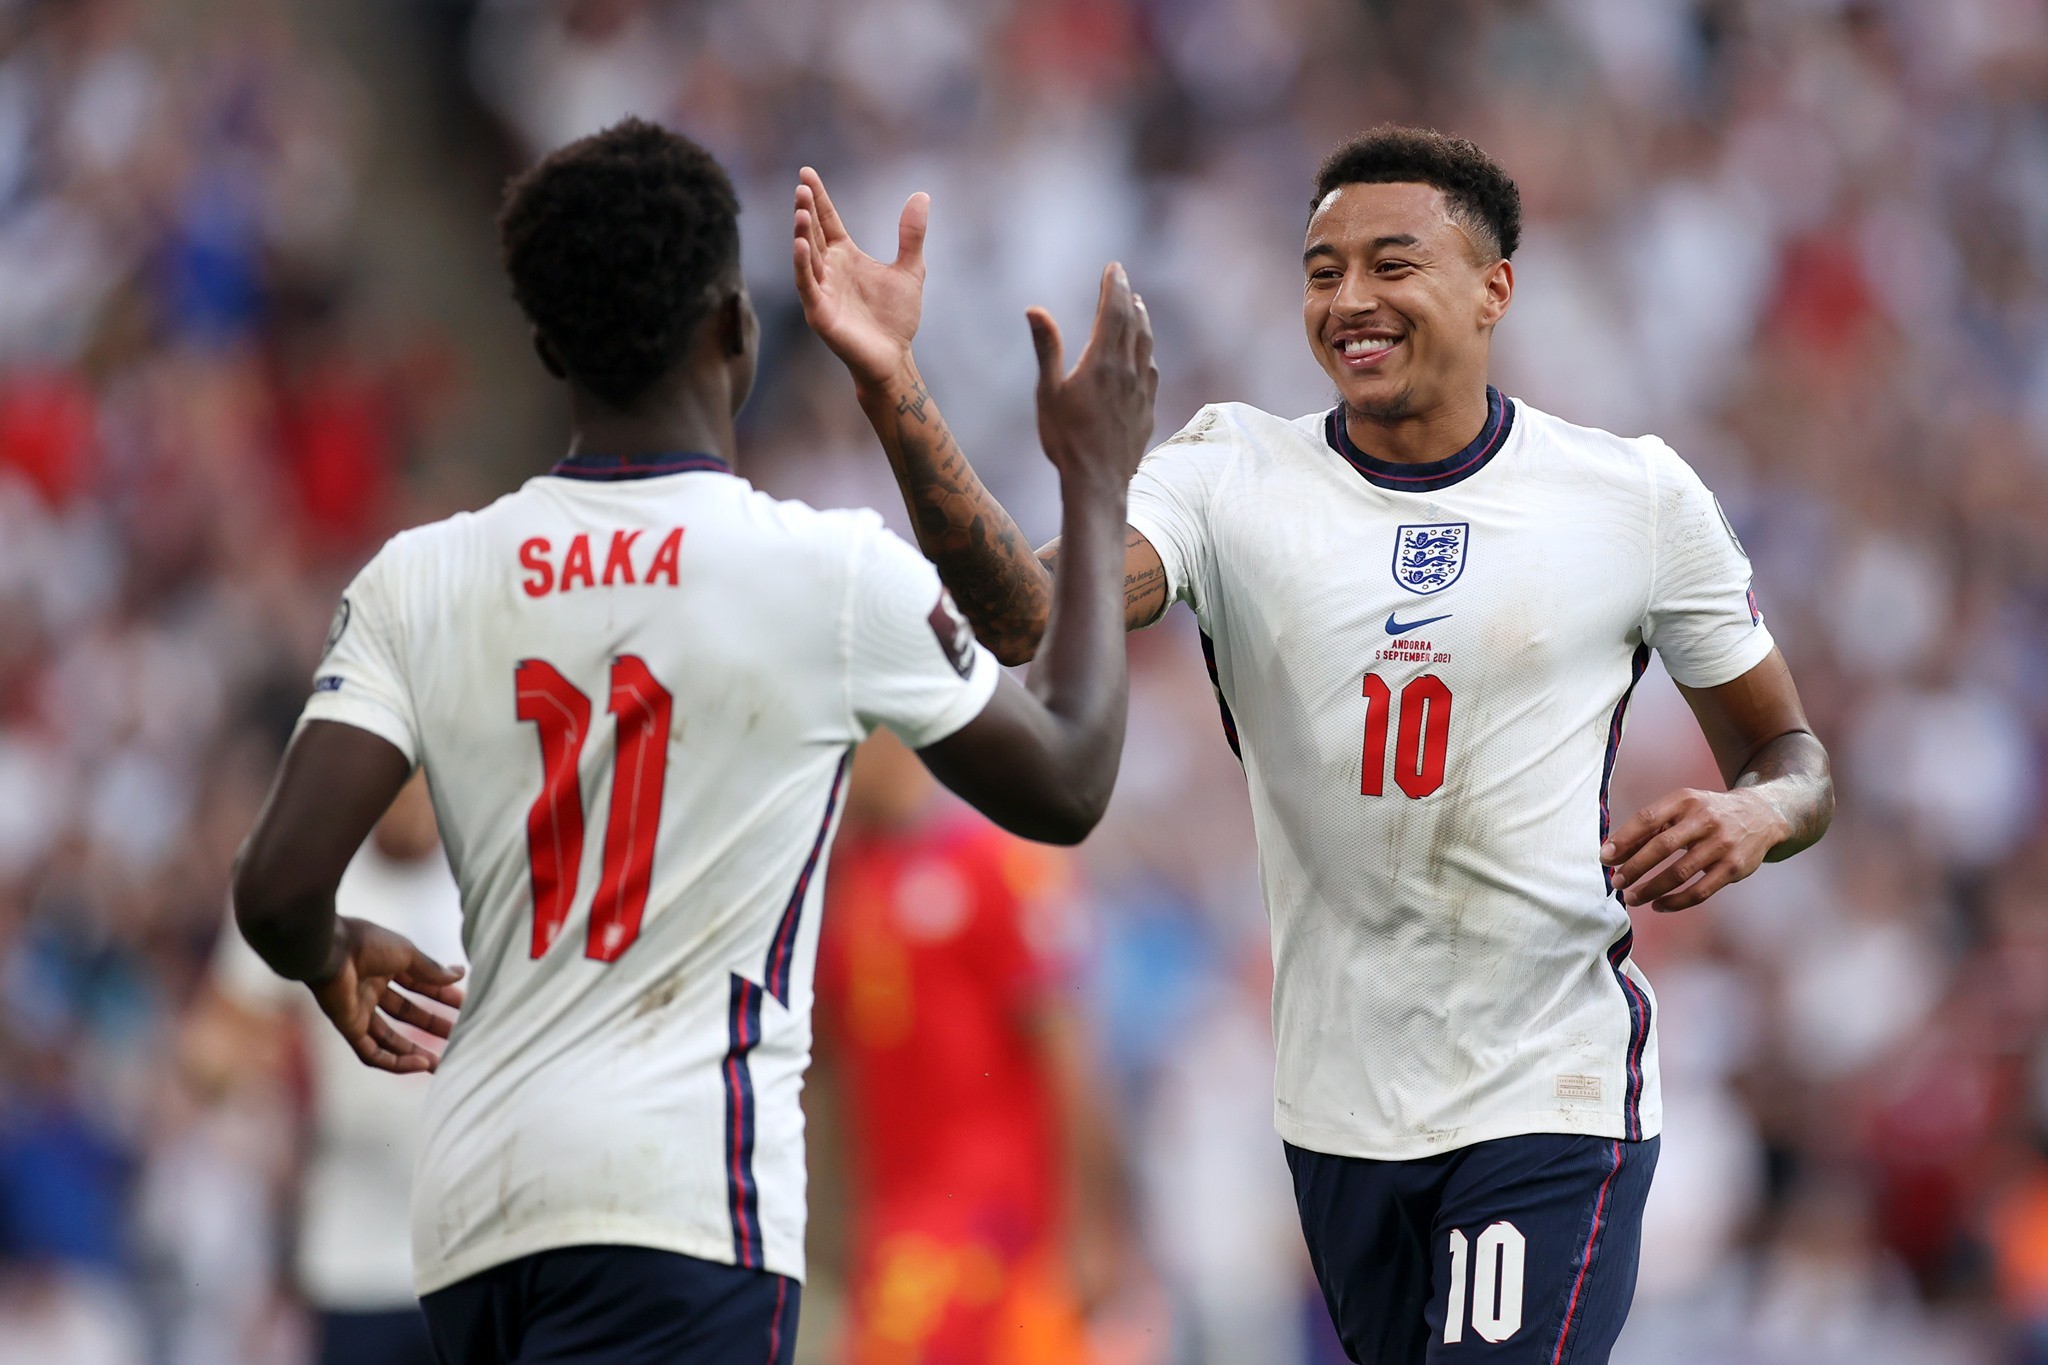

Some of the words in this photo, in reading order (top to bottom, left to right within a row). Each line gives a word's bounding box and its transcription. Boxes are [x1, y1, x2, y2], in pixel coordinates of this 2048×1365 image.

[519, 526, 685, 599] SAKA
[1375, 650, 1381, 660] 5
[1383, 650, 1430, 662] SEPTEMBER
[1433, 653, 1451, 663] 2021
[1392, 640, 1431, 651] ANDORRA
[1361, 673, 1453, 799] 10
[514, 654, 673, 963] 11
[1444, 1221, 1525, 1343] 10
